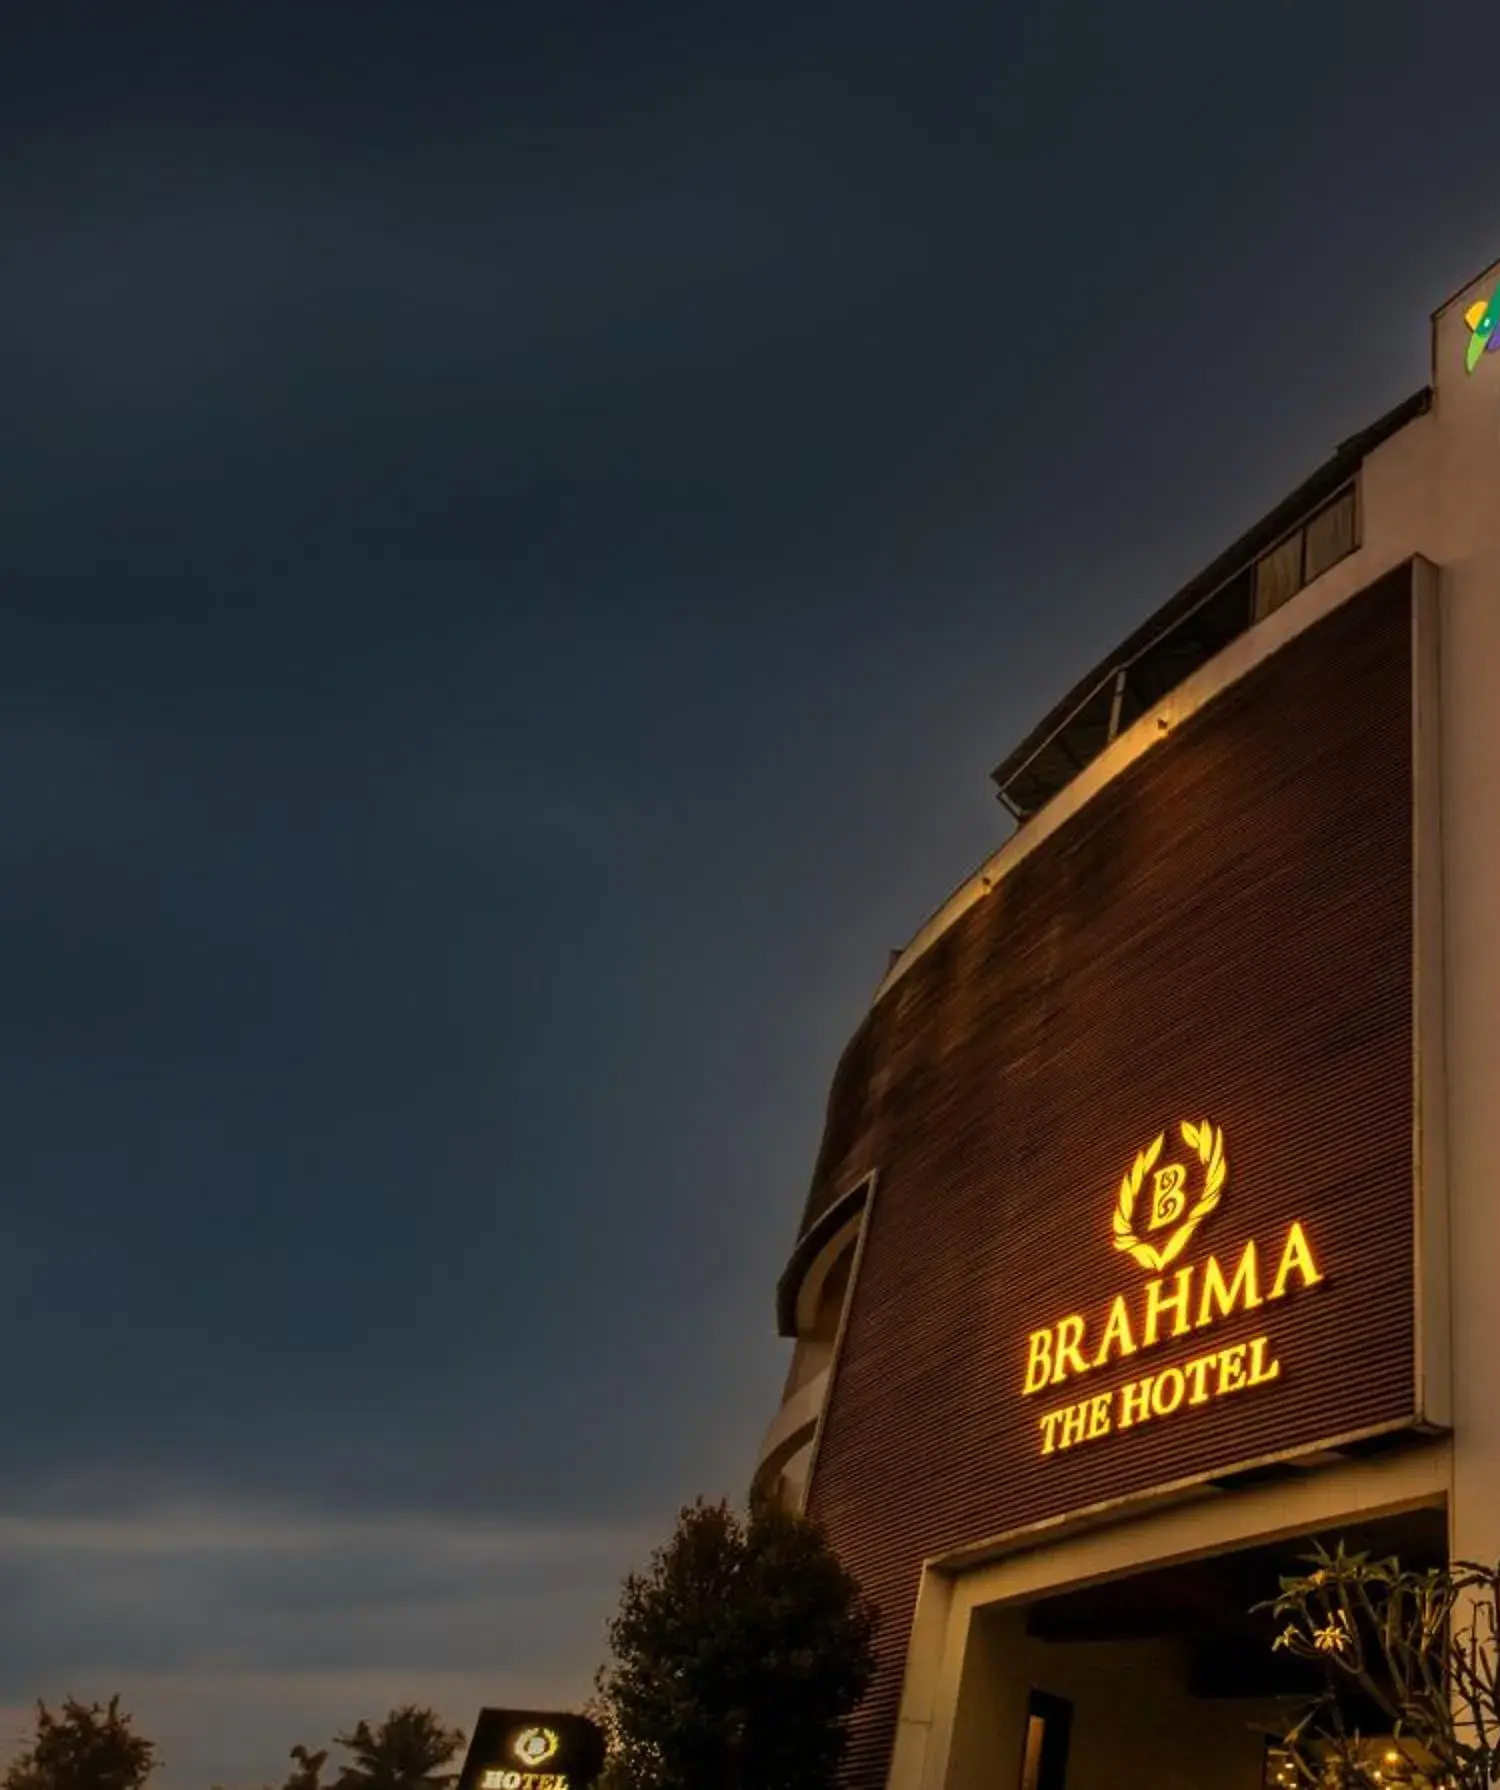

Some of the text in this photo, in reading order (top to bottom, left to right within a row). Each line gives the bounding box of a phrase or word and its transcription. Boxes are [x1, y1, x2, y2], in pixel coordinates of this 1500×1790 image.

[1022, 1220, 1324, 1396] BRAHMA
[1039, 1336, 1280, 1455] THE HOTEL
[481, 1770, 569, 1790] HOTEL
